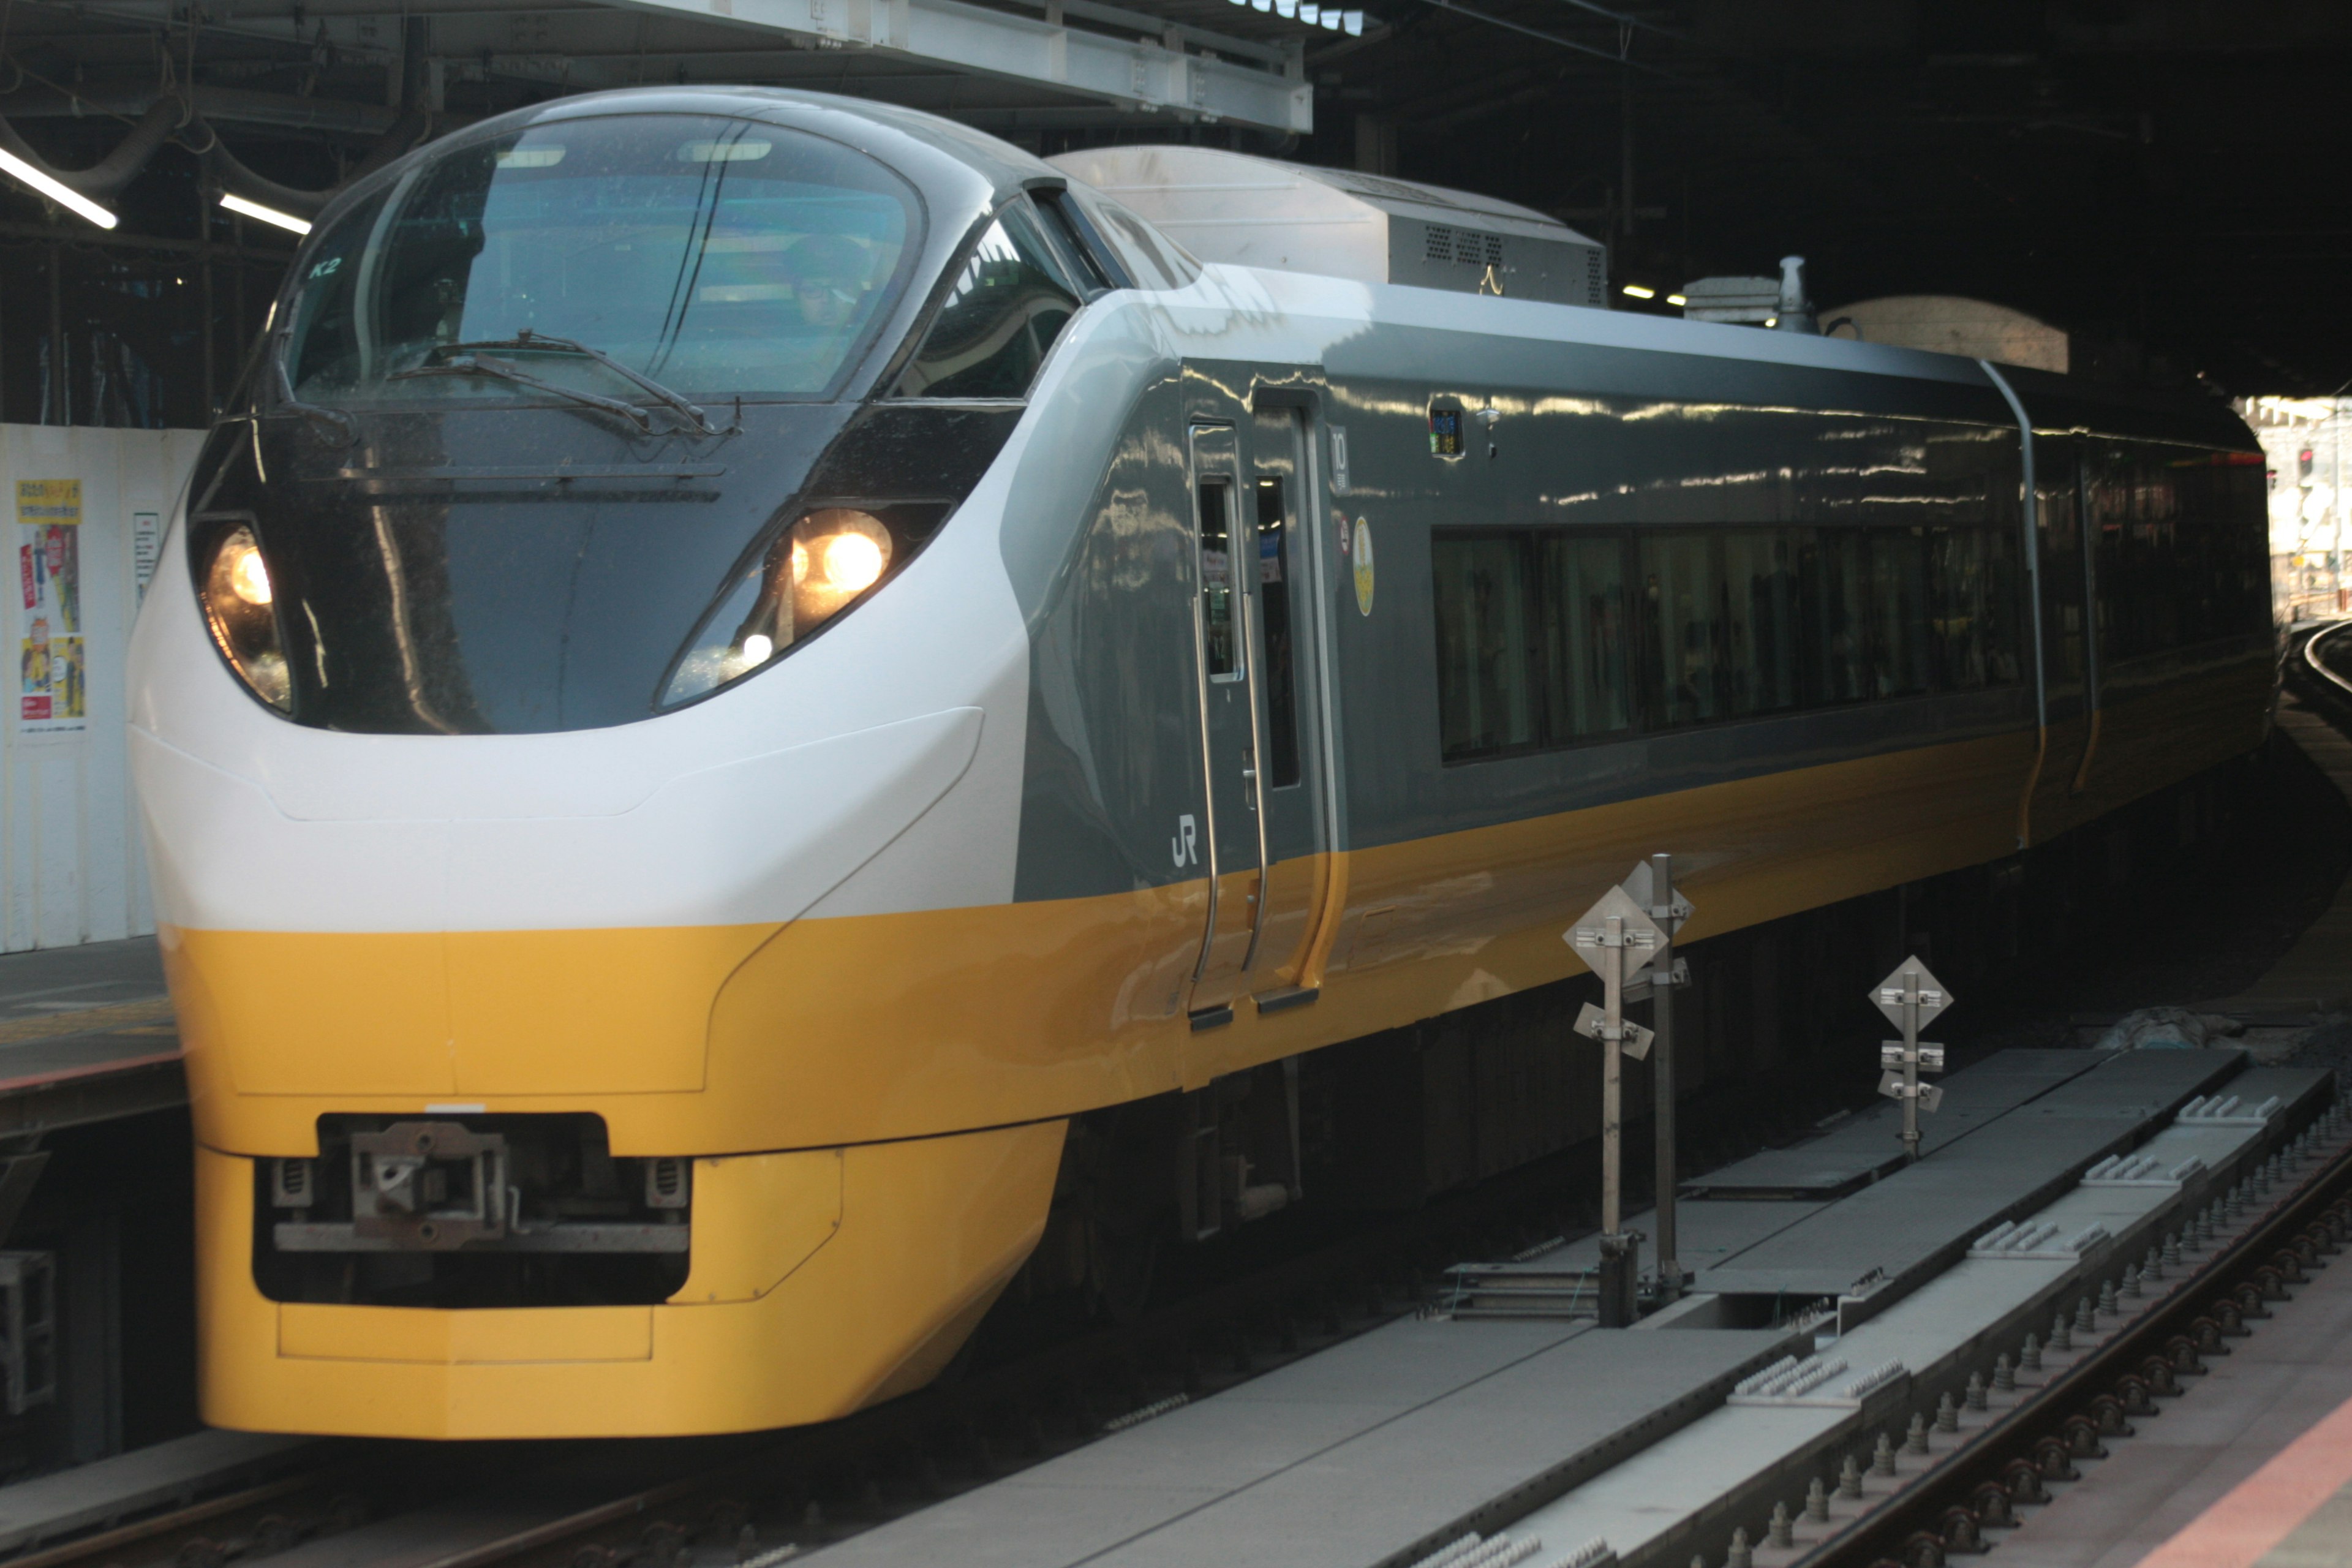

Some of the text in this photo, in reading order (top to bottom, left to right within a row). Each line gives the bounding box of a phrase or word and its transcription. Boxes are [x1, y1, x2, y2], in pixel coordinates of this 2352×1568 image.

[309, 257, 342, 279] K2
[1333, 433, 1346, 470] 10
[1172, 814, 1197, 867] JR
